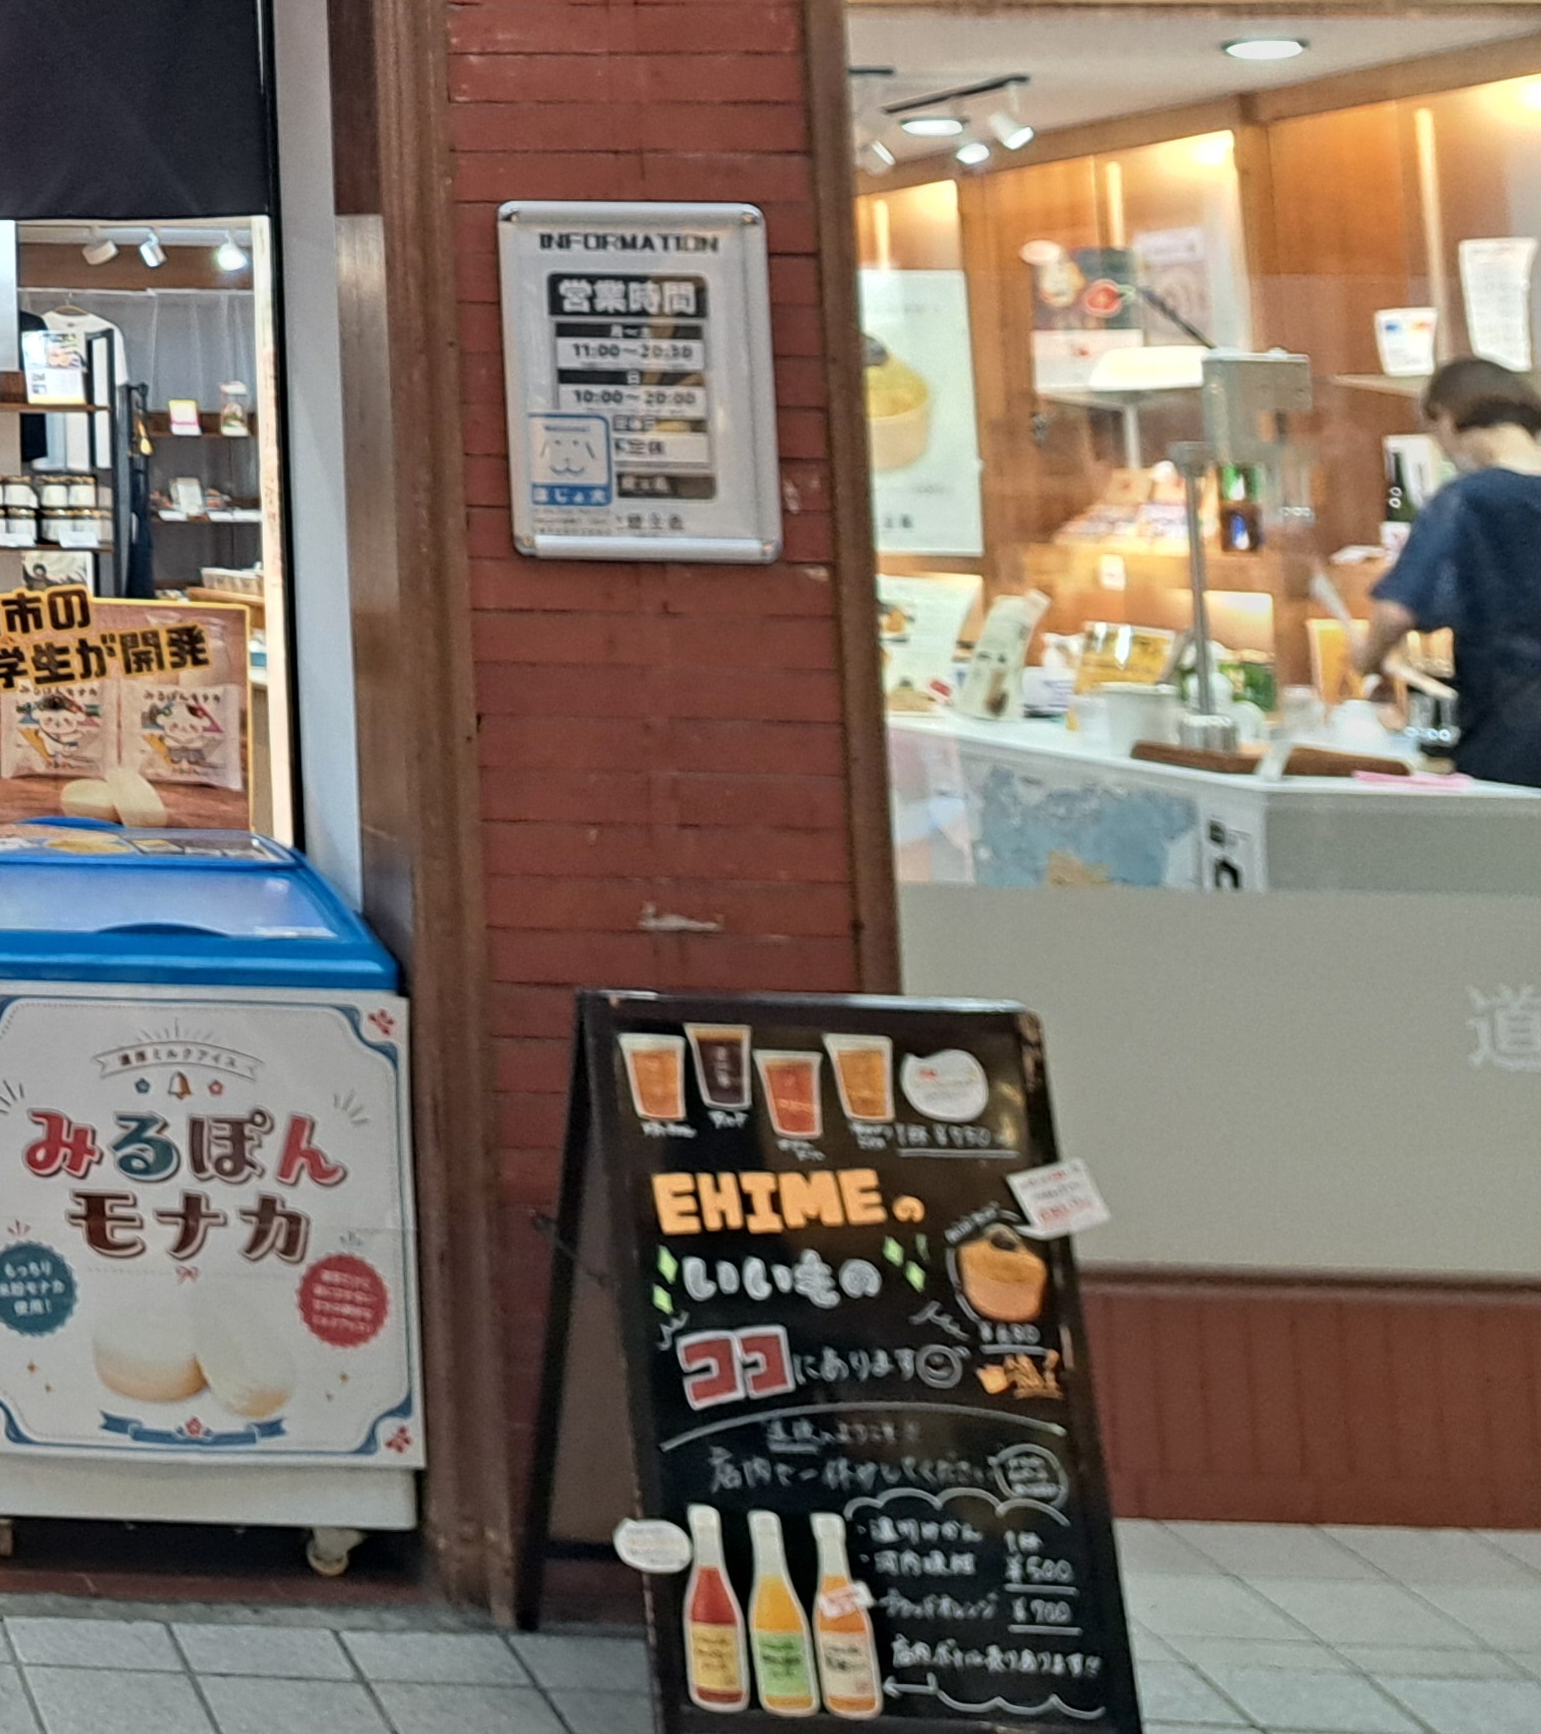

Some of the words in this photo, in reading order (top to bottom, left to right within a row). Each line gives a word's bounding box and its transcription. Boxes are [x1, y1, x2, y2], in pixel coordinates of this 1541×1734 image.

[539, 232, 720, 252] INFORMATION
[558, 278, 697, 315] 営業時間
[22, 1107, 347, 1186] みるぽん
[66, 1189, 313, 1264] モナカ
